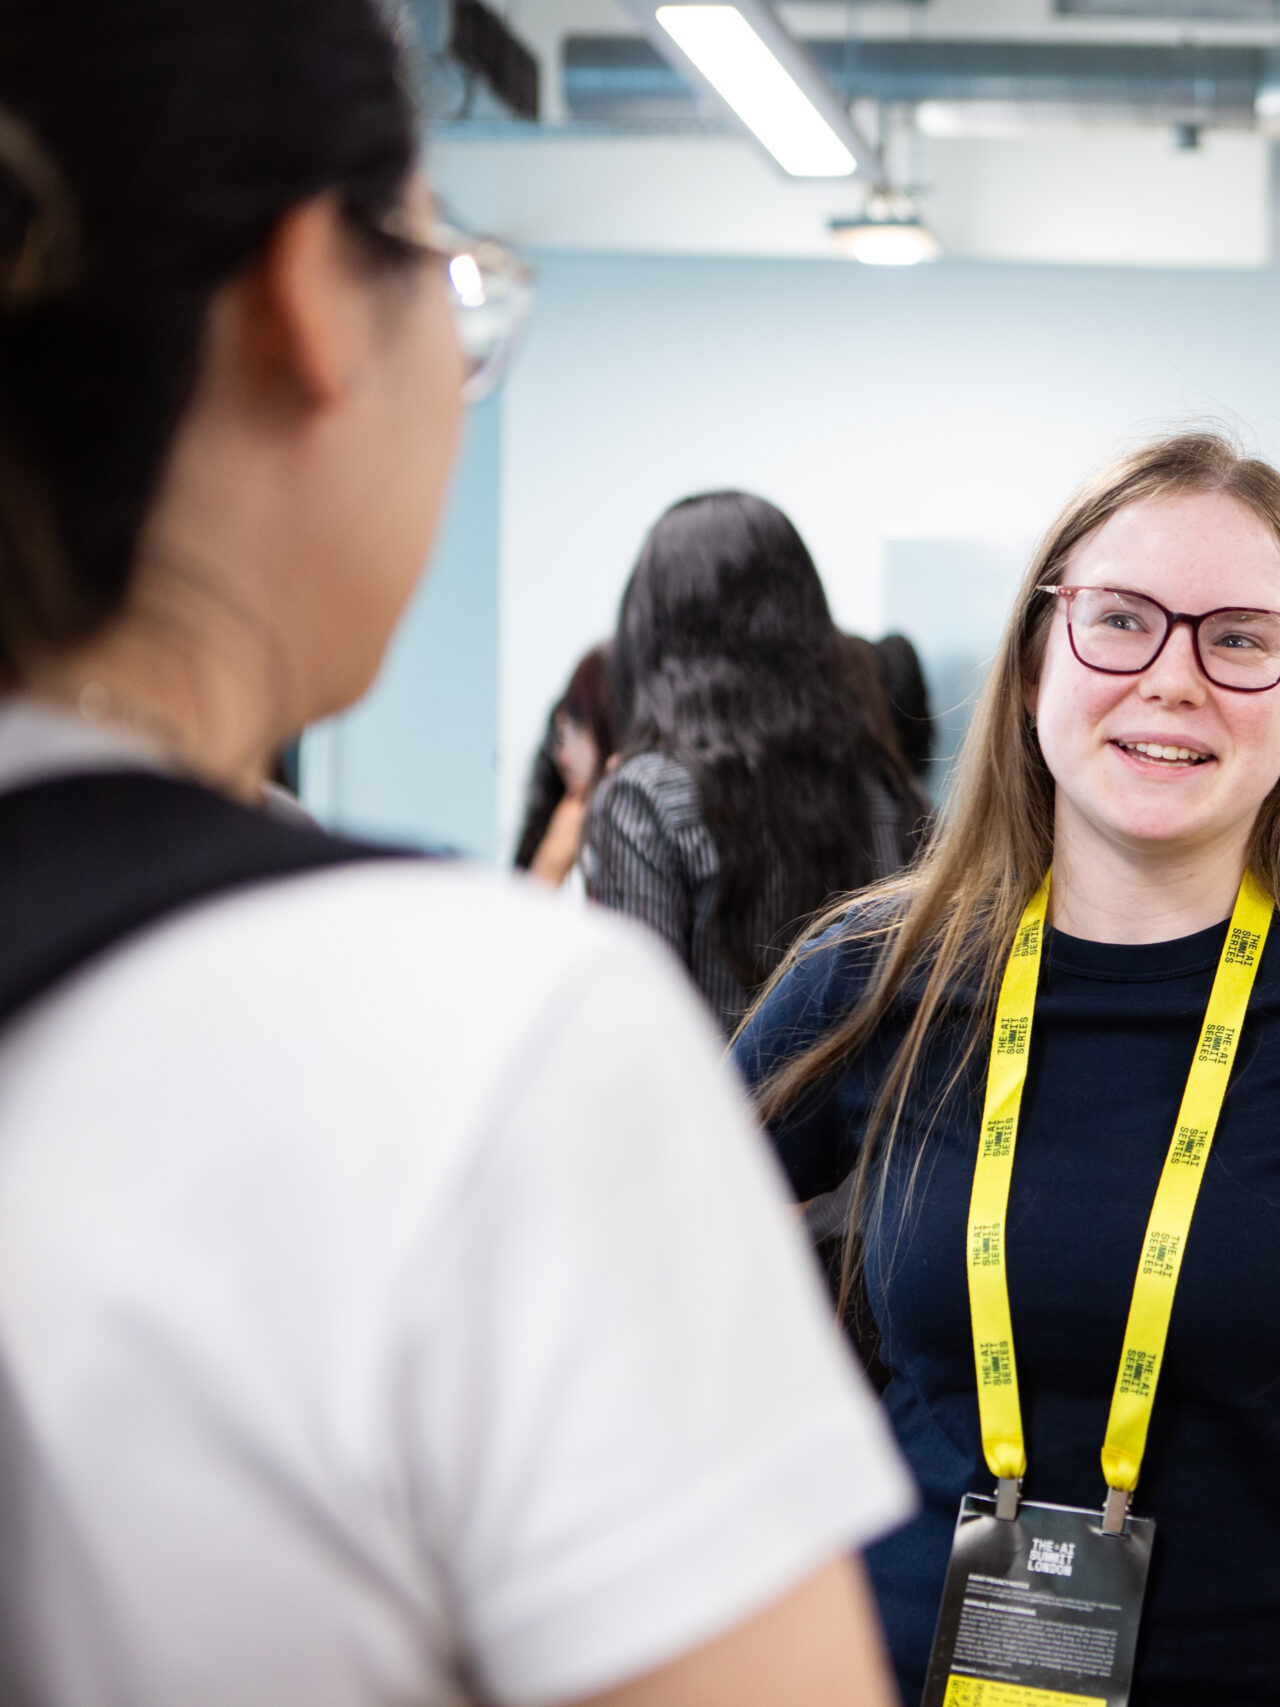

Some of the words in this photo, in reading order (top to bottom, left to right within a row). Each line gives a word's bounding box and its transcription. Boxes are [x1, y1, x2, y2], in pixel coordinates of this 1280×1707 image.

[1030, 919, 1040, 957] SERIES
[1225, 927, 1241, 964] SERIES
[1235, 930, 1251, 966] SUMMIT
[1250, 933, 1261, 950] THE
[997, 1037, 1008, 1055] THE
[1006, 1018, 1019, 1055] SUMMIT
[1016, 1016, 1029, 1055] SERIES
[1198, 1023, 1216, 1062] SERIES
[1208, 1025, 1225, 1064] SUMMIT
[1222, 1027, 1235, 1046] THE
[983, 1138, 995, 1157] THE
[992, 1119, 1005, 1157] SUMMIT
[1001, 1117, 1014, 1156] SERIES
[1171, 1126, 1190, 1165] SERIES
[1180, 1128, 1199, 1166] SUMMIT
[1195, 1130, 1208, 1149] THE
[973, 1246, 982, 1266] THE
[982, 1224, 991, 1266] SUMMIT
[991, 1222, 1000, 1265] SERIES
[1143, 1231, 1160, 1274] SERIES
[1153, 1233, 1170, 1275] SUMMIT
[1168, 1235, 1180, 1256] THE
[982, 1365, 992, 1386] THE
[989, 1342, 1002, 1386] SUMMIT
[999, 1340, 1012, 1385] SERIES
[1120, 1348, 1137, 1394] SERIES
[1130, 1351, 1146, 1395] SUMMIT
[1143, 1353, 1156, 1375] THE
[1029, 1550, 1075, 1566] SUMMIT
[1032, 1538, 1054, 1552] THE
[1060, 1541, 1076, 1555] AI
[1027, 1559, 1072, 1577] LONDON
